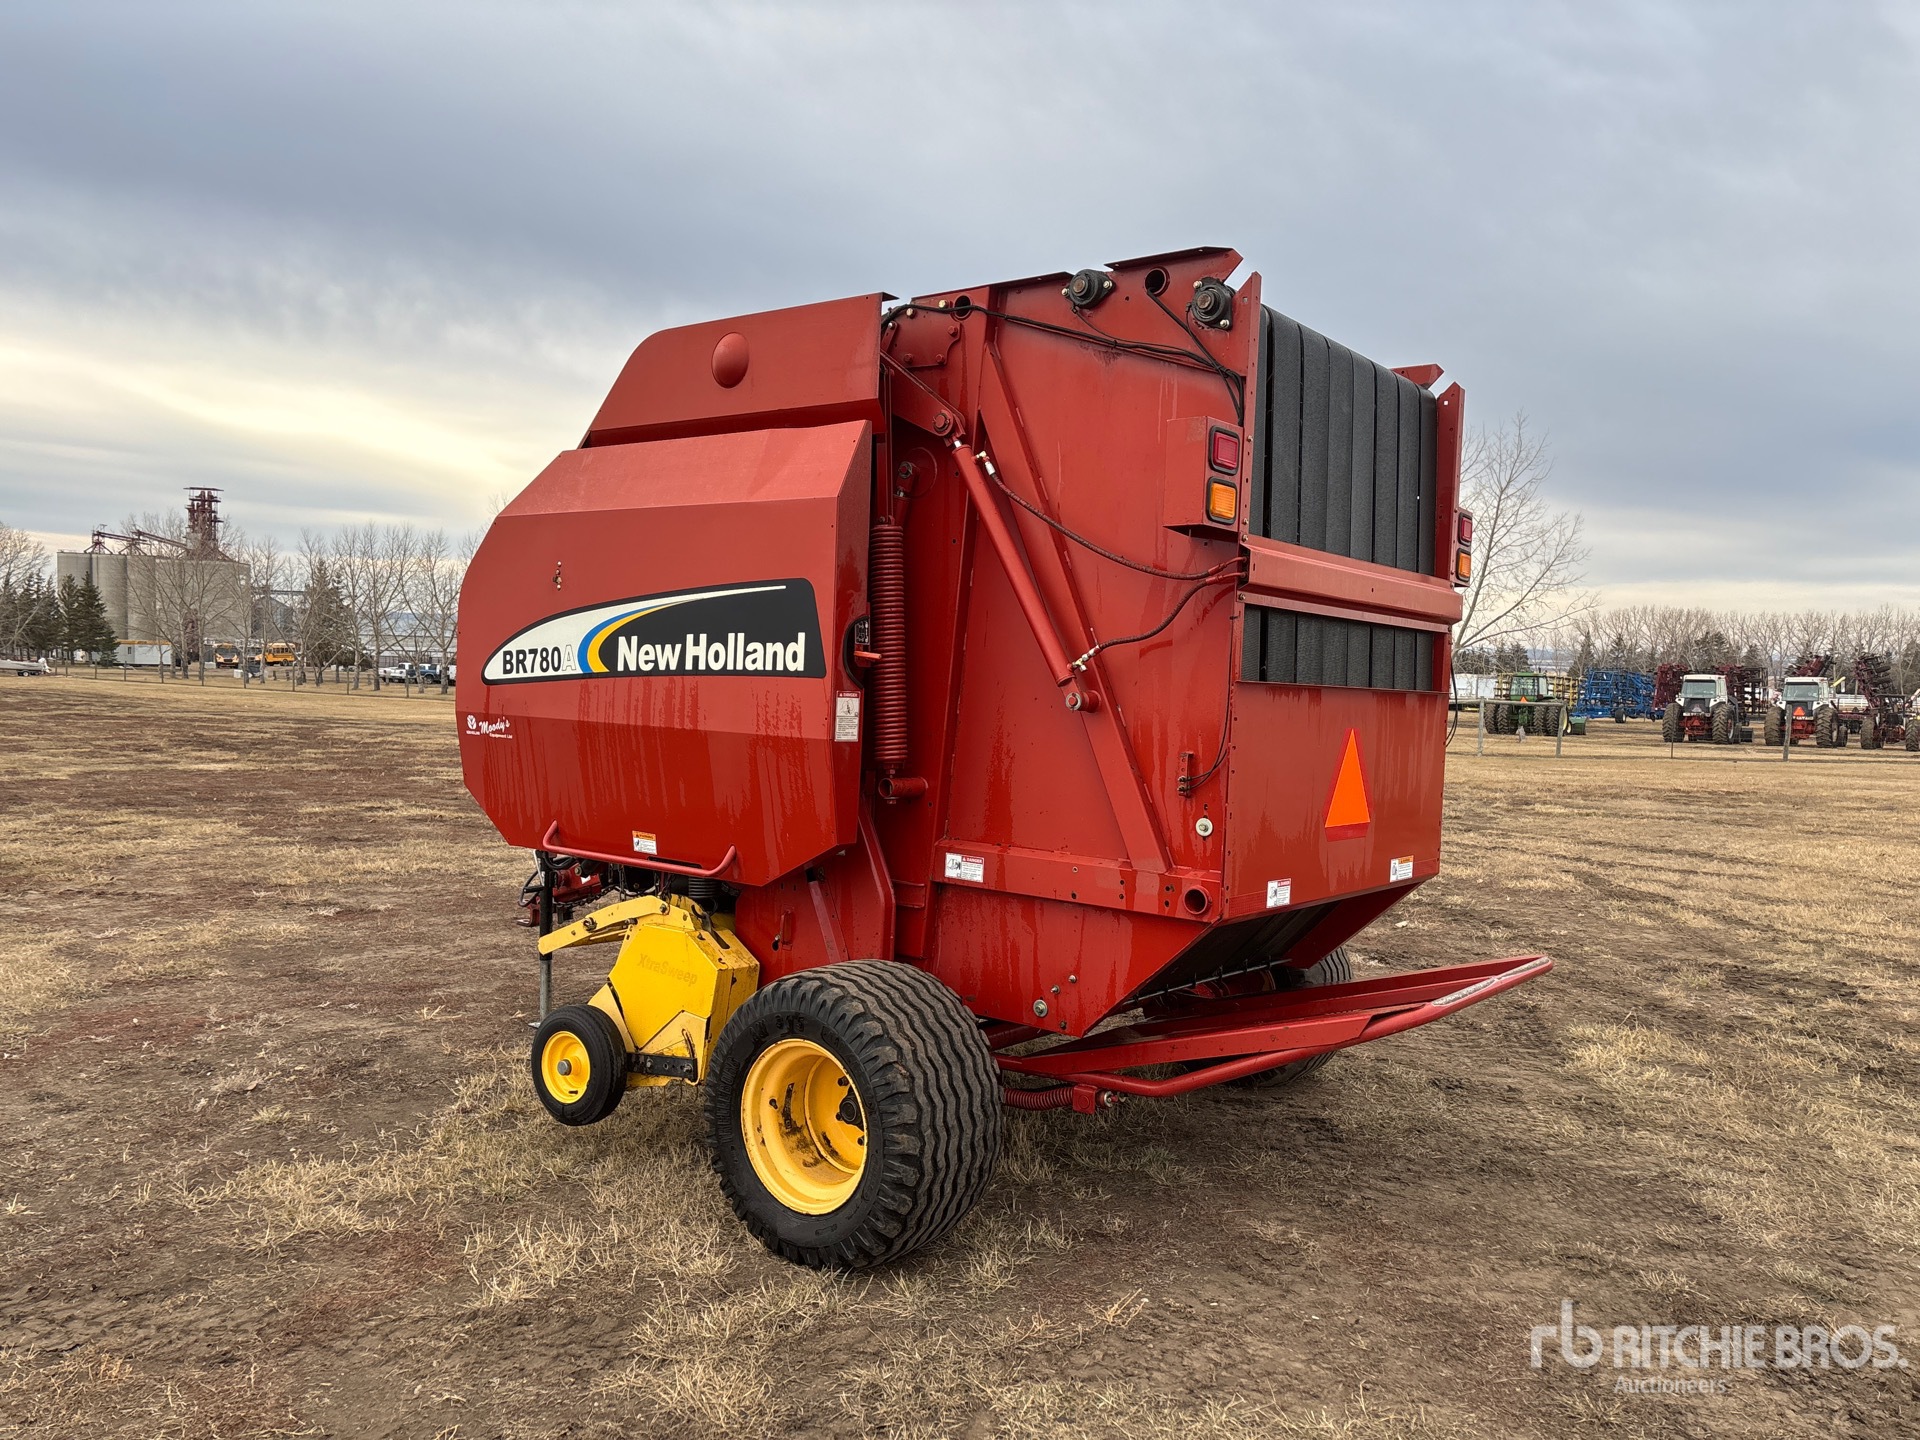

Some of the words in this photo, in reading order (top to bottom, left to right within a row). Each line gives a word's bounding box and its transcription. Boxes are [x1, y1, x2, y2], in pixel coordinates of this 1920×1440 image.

[502, 644, 577, 675] BR780A
[617, 635, 682, 671] New
[685, 632, 806, 672] Holland
[479, 716, 510, 733] Moody's
[637, 953, 698, 987] XtraSweep
